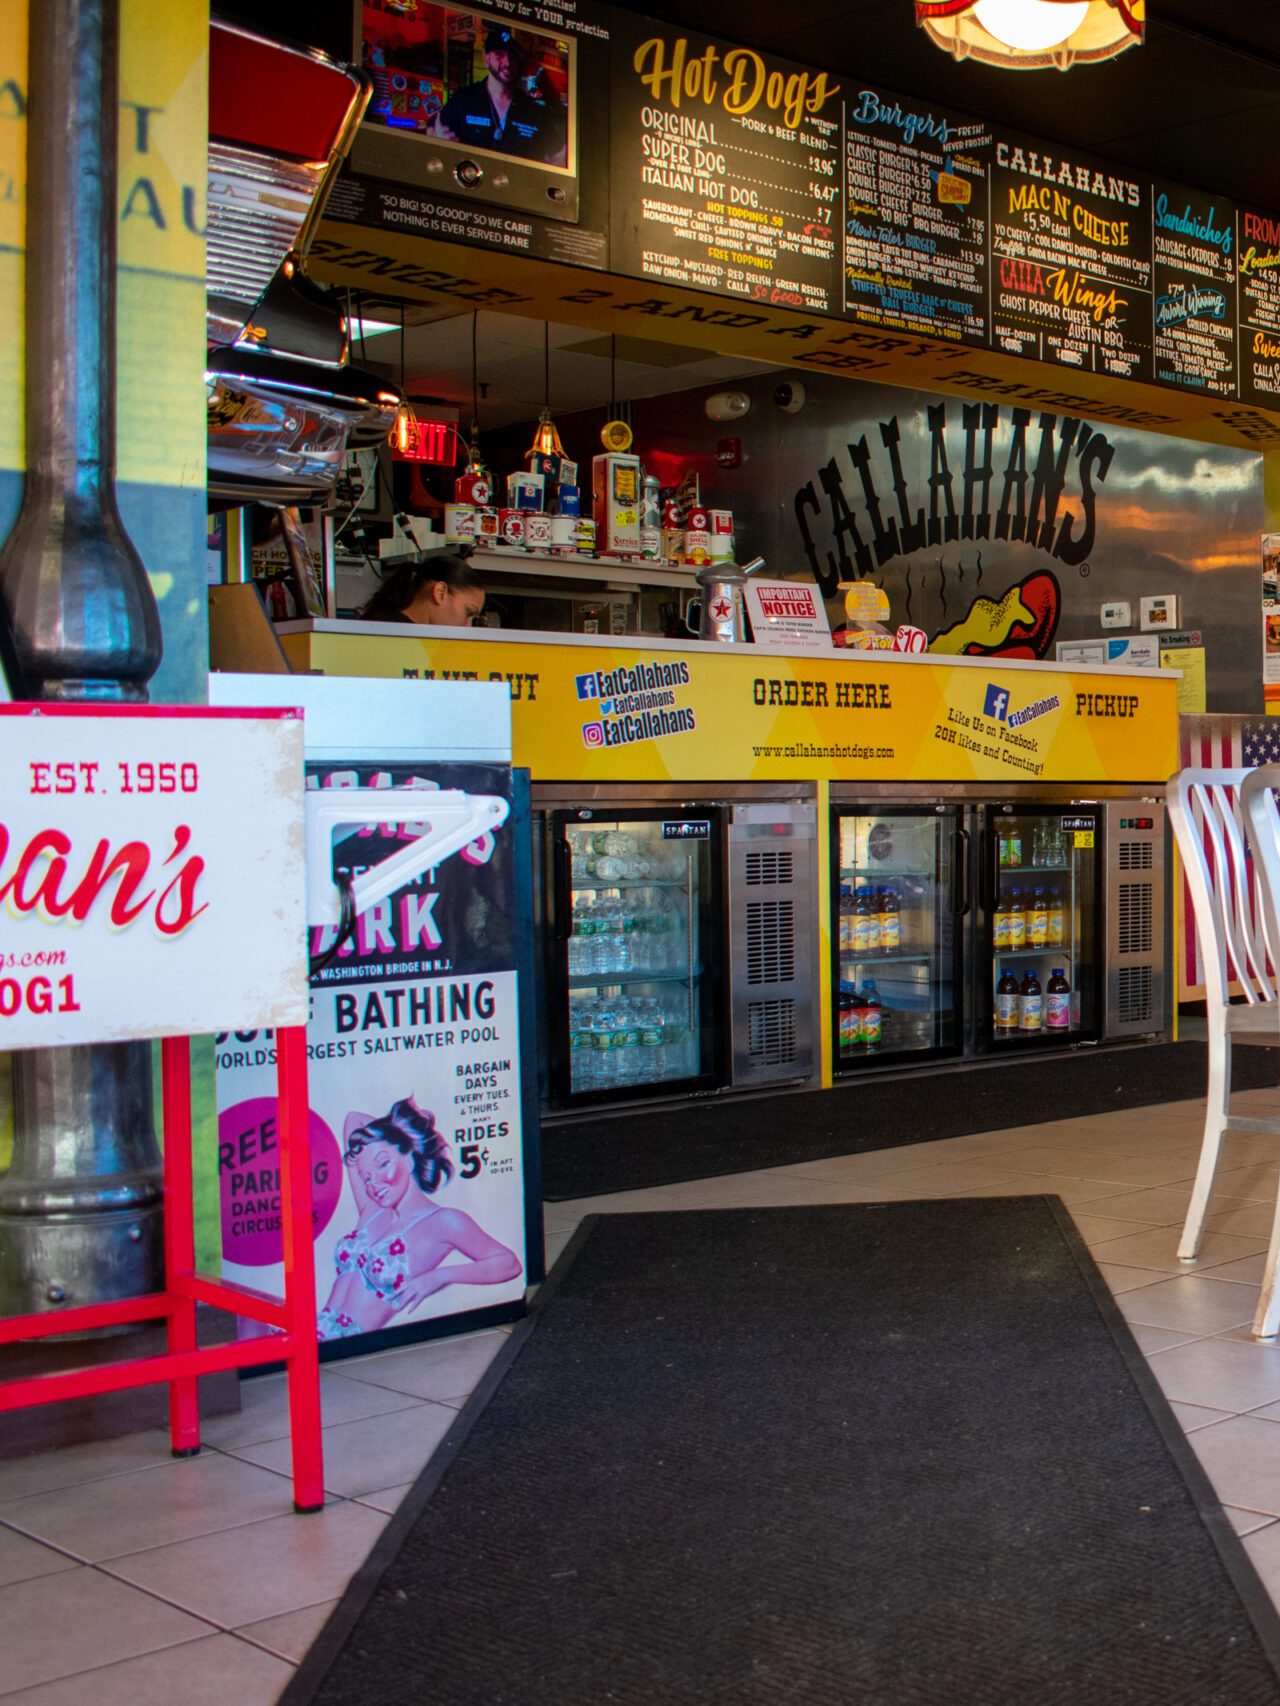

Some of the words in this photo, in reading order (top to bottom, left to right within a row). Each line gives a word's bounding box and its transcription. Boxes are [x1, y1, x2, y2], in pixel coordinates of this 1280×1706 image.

[517, 4, 532, 16] for
[535, 8, 564, 26] YOUR
[566, 18, 609, 39] protection
[633, 38, 720, 108] Hot
[723, 49, 840, 129] Dogs
[641, 106, 718, 145] ORIGINAL
[853, 90, 958, 144] Burgers
[957, 123, 985, 136] FRESH!
[741, 116, 767, 133] PORK
[776, 126, 797, 142] BEEF
[800, 133, 829, 151] BLEND
[642, 134, 690, 165] SUPER
[695, 149, 726, 175] DOG
[847, 142, 877, 163] CLASSIC
[879, 150, 911, 171] BURGER
[641, 166, 694, 193] ITALIAN
[699, 178, 725, 200] HOT
[730, 185, 758, 209] DOG
[847, 157, 876, 177] CHEESE
[879, 164, 911, 186] BURGER
[848, 171, 877, 191] DOUBLE
[879, 178, 911, 200] BURGER
[996, 142, 1141, 207] CALLAHAN'S
[383, 210, 430, 229] NOTHING
[431, 219, 440, 230] IS
[442, 221, 465, 235] EVER
[467, 227, 503, 243] SERVED
[503, 235, 529, 248] RARE
[399, 198, 419, 212] BIG!
[420, 202, 435, 214] SO
[473, 213, 487, 225] SO
[488, 218, 503, 229] WE
[504, 220, 532, 236] CARE!
[707, 201, 725, 214] HOT
[727, 205, 769, 225] TOPPINGS
[1009, 184, 1051, 214] MAC
[1053, 190, 1071, 221] N'
[1073, 205, 1129, 246] CHEESE
[1155, 193, 1232, 254] Sandwiches
[1051, 223, 1071, 239] EACH!
[643, 250, 680, 268] KETCHUP
[684, 260, 724, 277] MUSTARD
[727, 268, 744, 281] RED
[746, 272, 771, 287] RELISH
[775, 278, 799, 292] GREEN
[708, 247, 729, 261] FREE
[732, 252, 773, 271] TOPPINGS
[1000, 258, 1046, 296] CALLA
[1045, 269, 1128, 322] Wings
[1000, 293, 1027, 311] GHOST
[1029, 299, 1061, 320] PEPPER
[1062, 307, 1091, 326] CHEESE
[1068, 323, 1101, 344] AUSTIN
[1104, 330, 1124, 349] BBQ
[1253, 362, 1274, 379] CALLA
[794, 401, 1116, 600] CALLAHAN'S
[759, 587, 810, 601] IMPORTANT
[763, 601, 816, 617] NOTICE
[875, 637, 893, 649] TOY
[897, 625, 926, 653] $10
[1168, 635, 1190, 644] Smoking
[595, 660, 690, 698] EatCallahans
[753, 678, 828, 708] ORDER
[836, 682, 892, 710] HERE
[613, 690, 675, 715] EatCallahans
[1016, 695, 1060, 727] EatCallahans
[1075, 692, 1140, 718] PICKUP
[602, 707, 696, 747] EatCallahans
[947, 706, 970, 728] Like
[972, 712, 985, 732] Us
[999, 725, 1039, 754] Facebook
[753, 742, 895, 759] www.callahanshotdogs.com
[934, 724, 956, 741] 20K
[958, 733, 982, 753] likes
[983, 743, 999, 760] and
[1001, 748, 1045, 776] Counting!
[30, 762, 107, 795] EST.
[119, 762, 200, 794] 1950
[0, 822, 210, 935] an's
[320, 963, 384, 980] WASHINGTON
[386, 961, 420, 976] BRIDGE
[422, 960, 432, 973] IN
[435, 959, 453, 972] N.J.
[334, 979, 496, 1035] BATHING
[364, 1030, 455, 1055] SALTWATER
[460, 1027, 500, 1046] POOL
[215, 1047, 278, 1070] ORLD'S
[456, 1059, 512, 1077] BARGAIN
[454, 1091, 485, 1105] EVERY
[486, 1089, 511, 1102] TUES.
[464, 1075, 497, 1089] DAYS
[468, 1102, 501, 1115] THURS.
[454, 1122, 510, 1144] RIDES
[459, 1144, 491, 1180] 5¢
